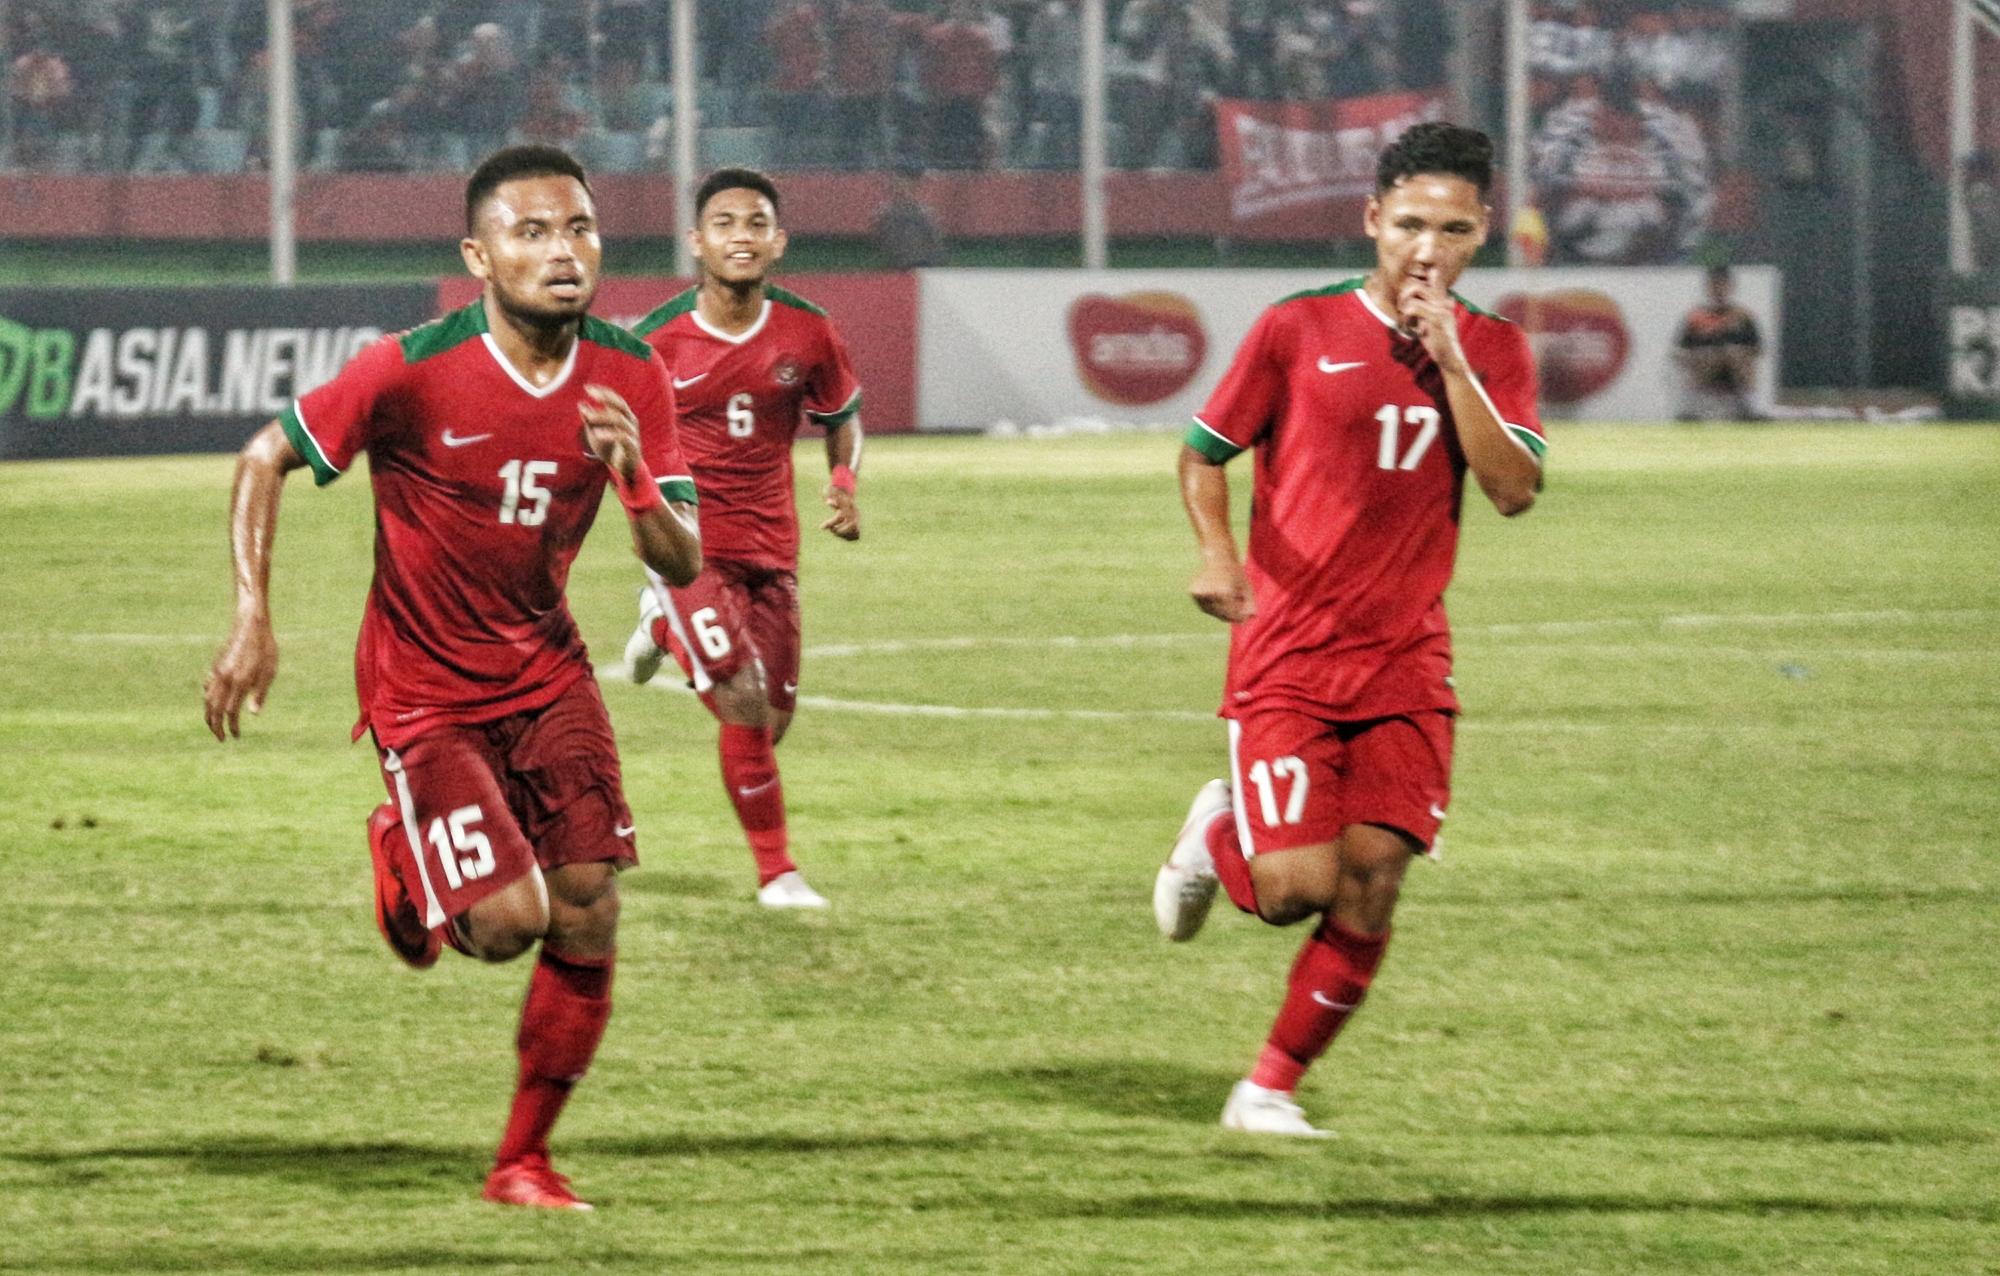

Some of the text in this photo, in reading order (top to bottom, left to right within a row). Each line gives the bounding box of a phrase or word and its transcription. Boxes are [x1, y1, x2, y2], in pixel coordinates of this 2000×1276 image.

[726, 393, 756, 438] 6
[1374, 403, 1441, 470] 17
[498, 459, 559, 526] 15
[690, 607, 731, 659] 6
[1249, 755, 1309, 827] 17
[428, 804, 496, 890] 15
